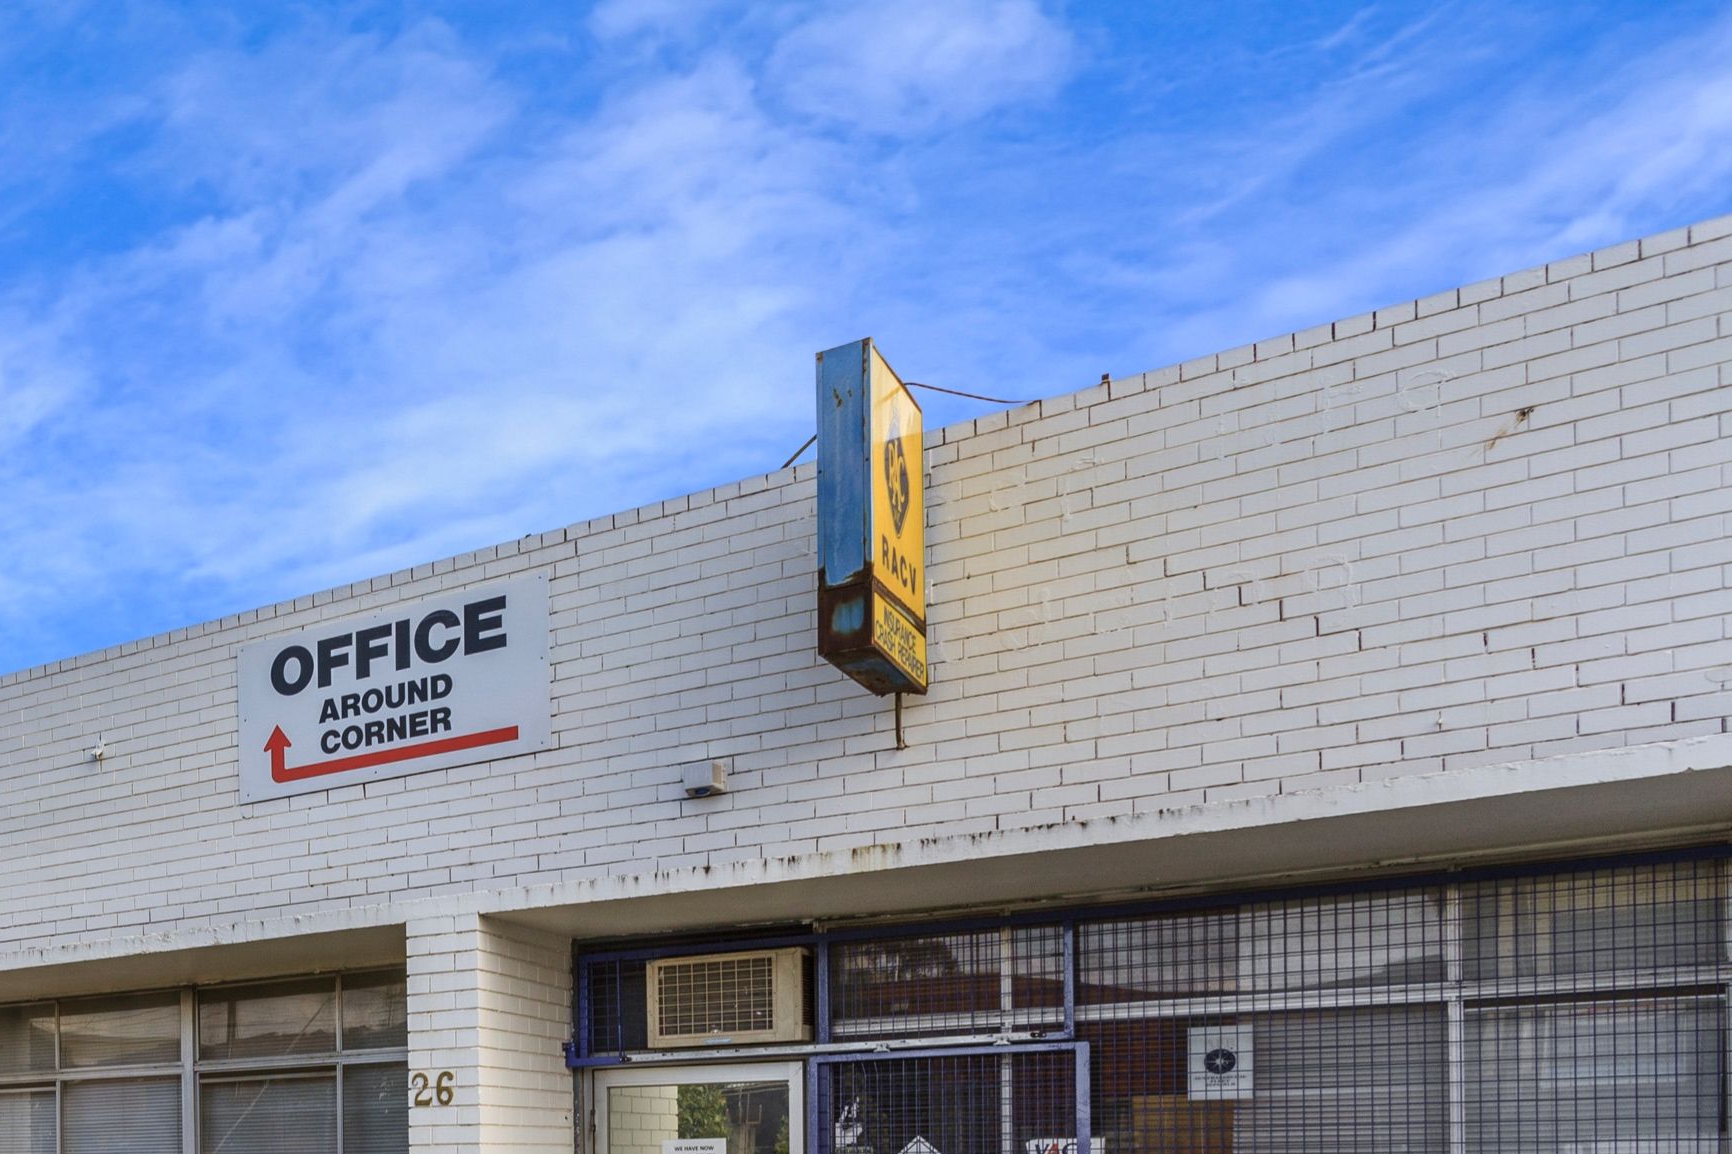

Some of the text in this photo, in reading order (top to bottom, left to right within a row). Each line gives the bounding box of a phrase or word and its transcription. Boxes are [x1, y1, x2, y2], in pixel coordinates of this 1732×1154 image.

[882, 534, 916, 595] RACV
[270, 595, 507, 696] OFFICE
[319, 674, 453, 724] AROUND
[321, 707, 452, 754] CORNER
[412, 1071, 454, 1106] 26
